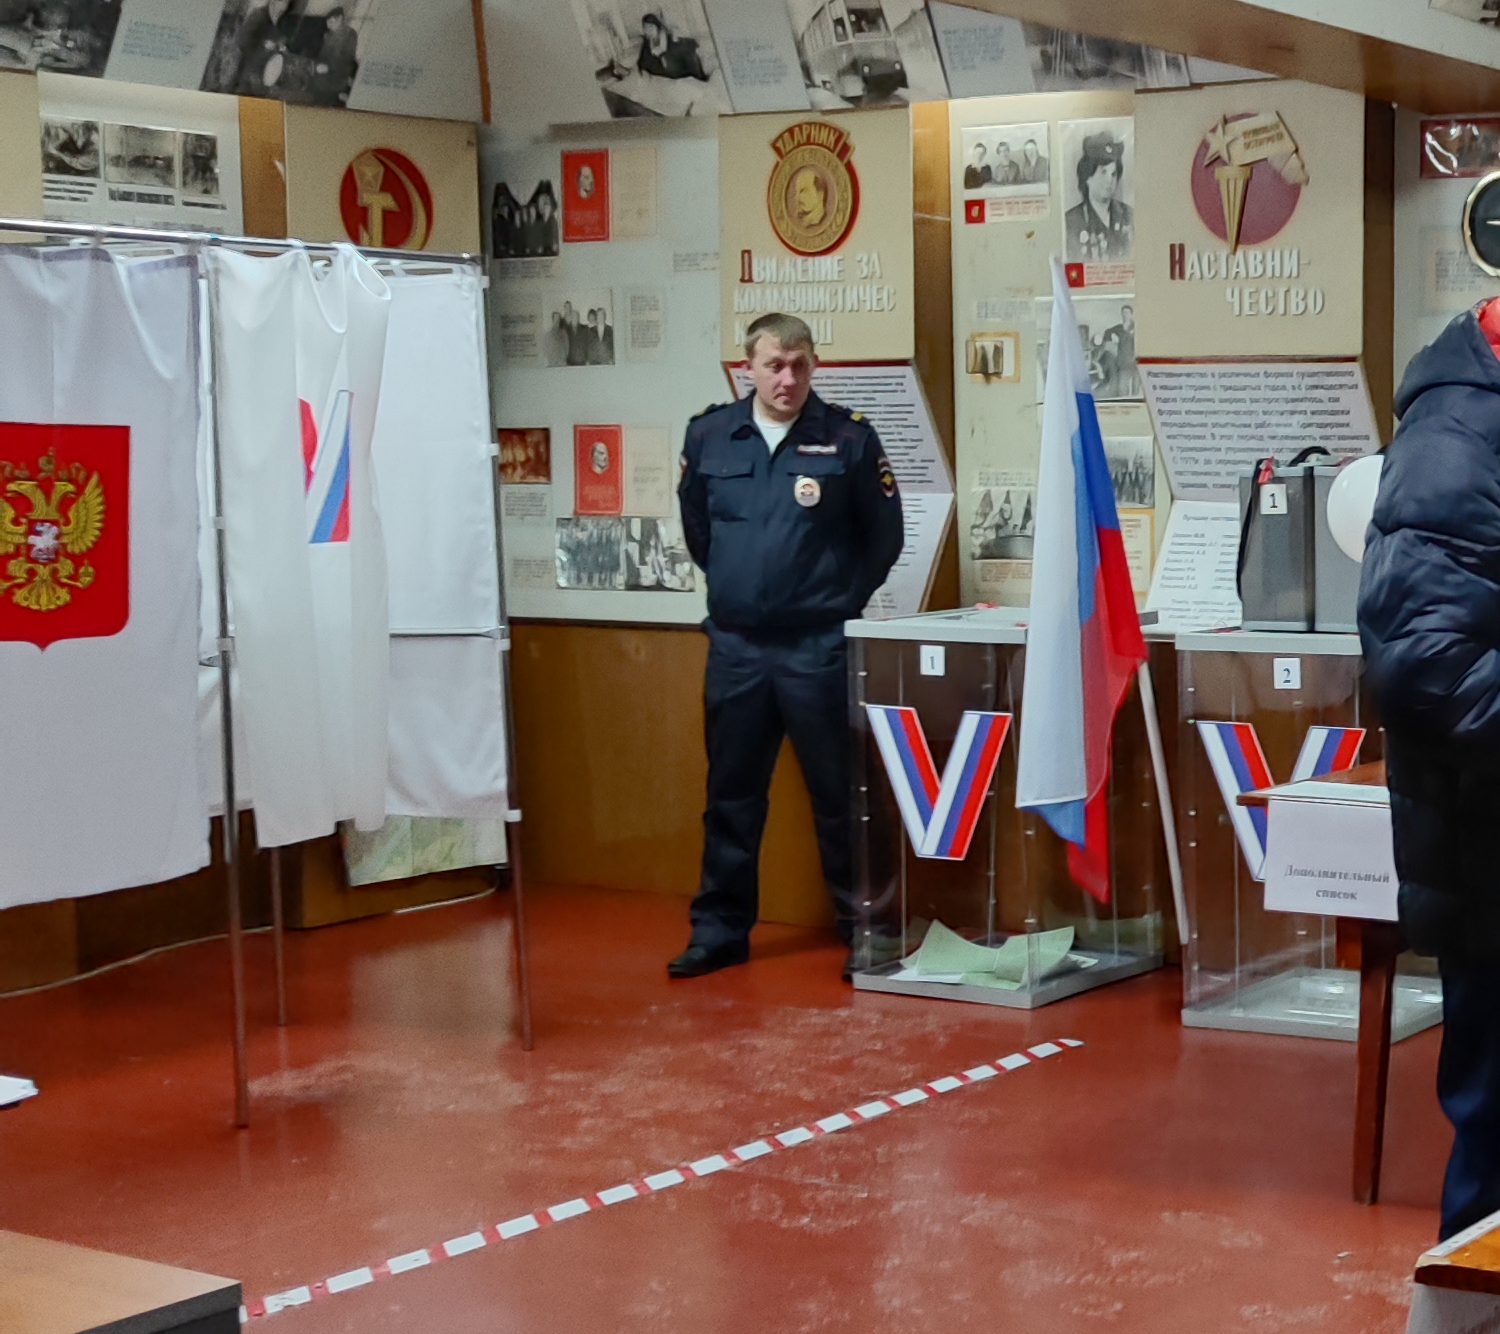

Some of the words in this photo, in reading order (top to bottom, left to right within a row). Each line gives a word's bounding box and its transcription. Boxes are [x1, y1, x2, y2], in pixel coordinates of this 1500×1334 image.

[857, 252, 882, 280] ЗА
[1226, 286, 1325, 316] ЧЕСТВО
[1270, 493, 1278, 508] 1
[1282, 667, 1292, 684] 2
[1284, 865, 1390, 884] Дополнительный
[1315, 889, 1358, 900] список
